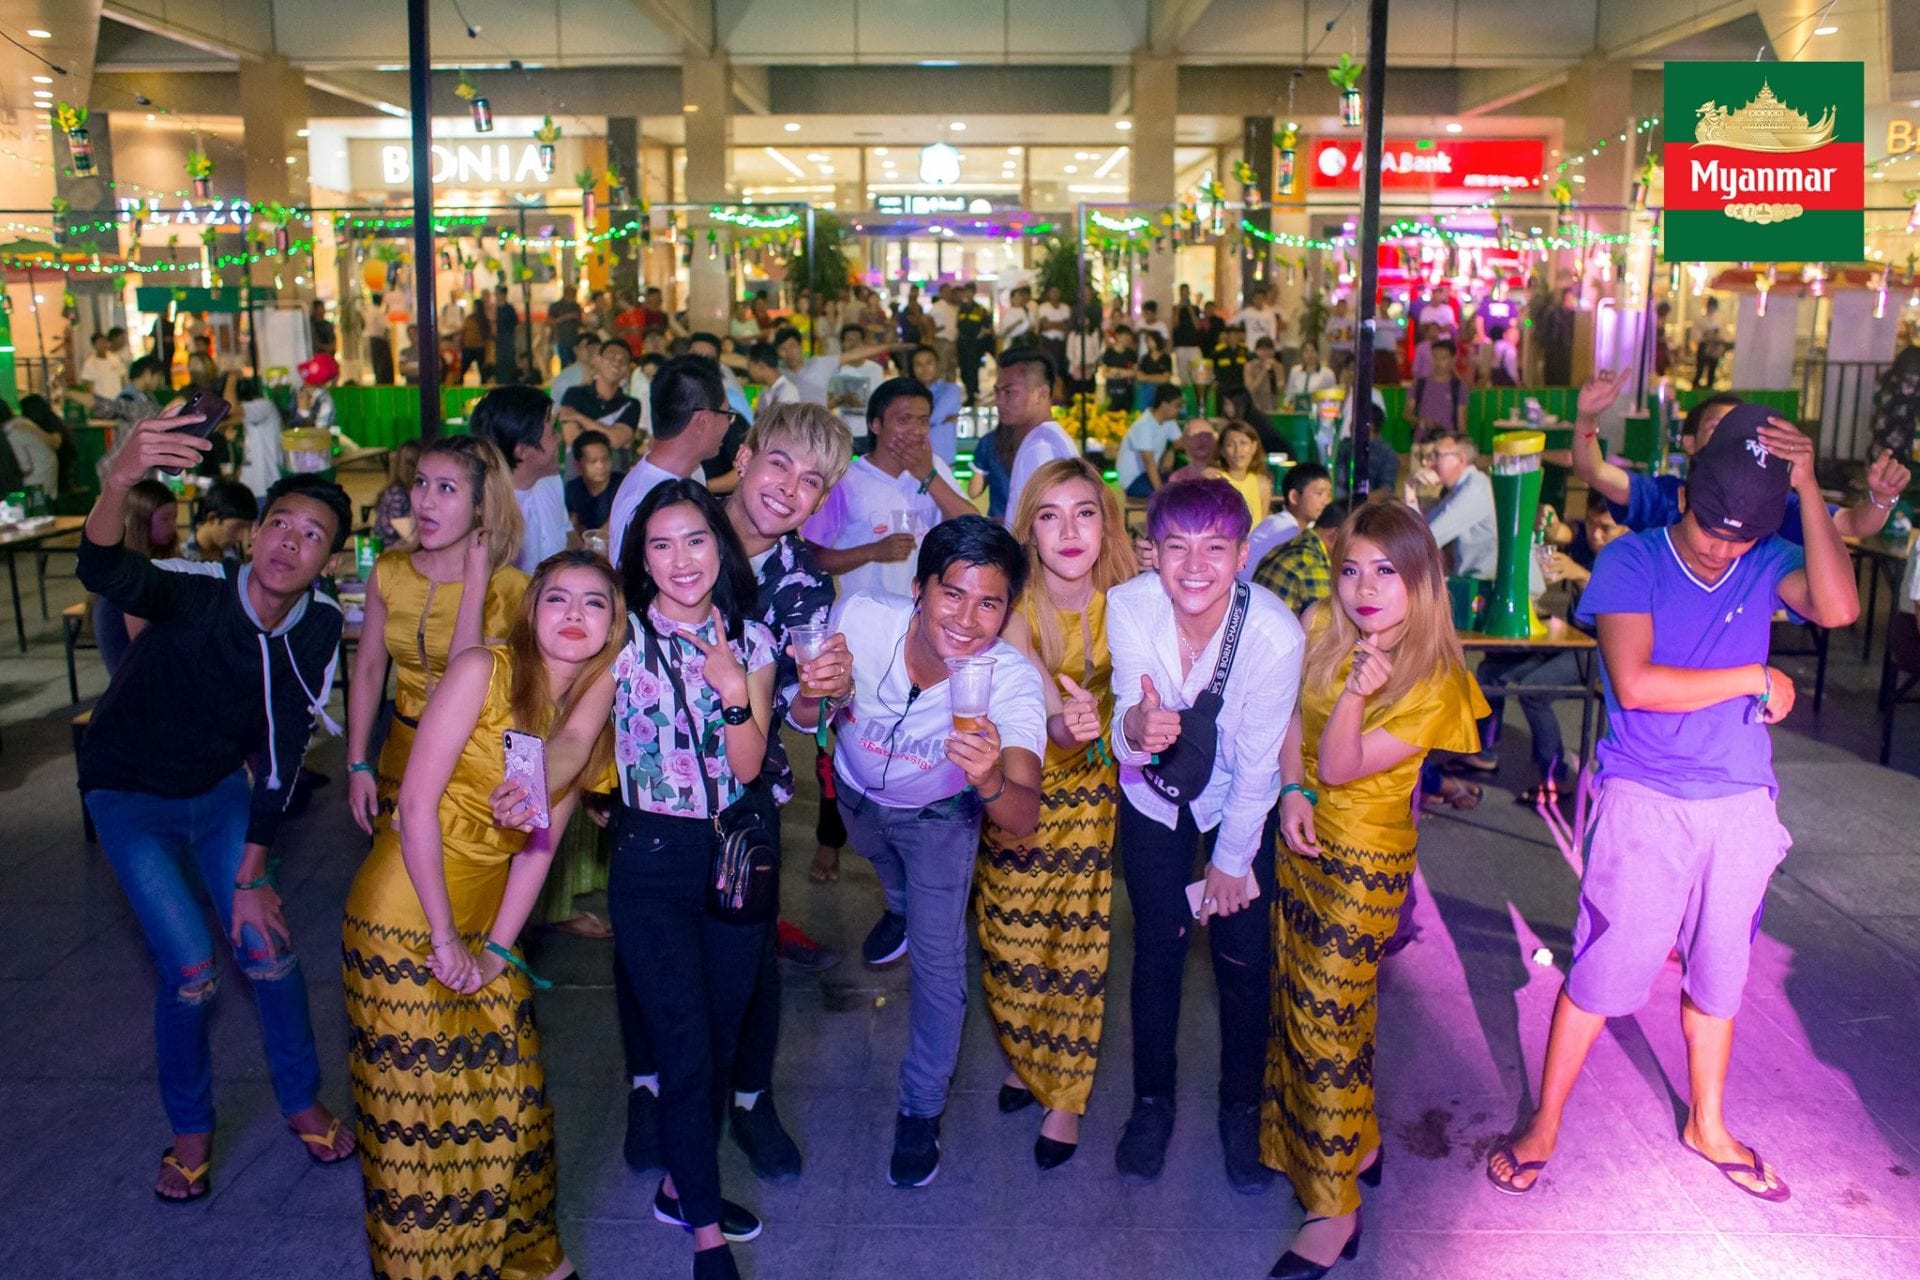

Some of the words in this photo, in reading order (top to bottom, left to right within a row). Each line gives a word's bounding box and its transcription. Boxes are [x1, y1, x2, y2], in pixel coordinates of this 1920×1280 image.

[1399, 150, 1453, 174] Bank
[1219, 642, 1233, 669] BORN
[1226, 607, 1243, 643] CHAMPS
